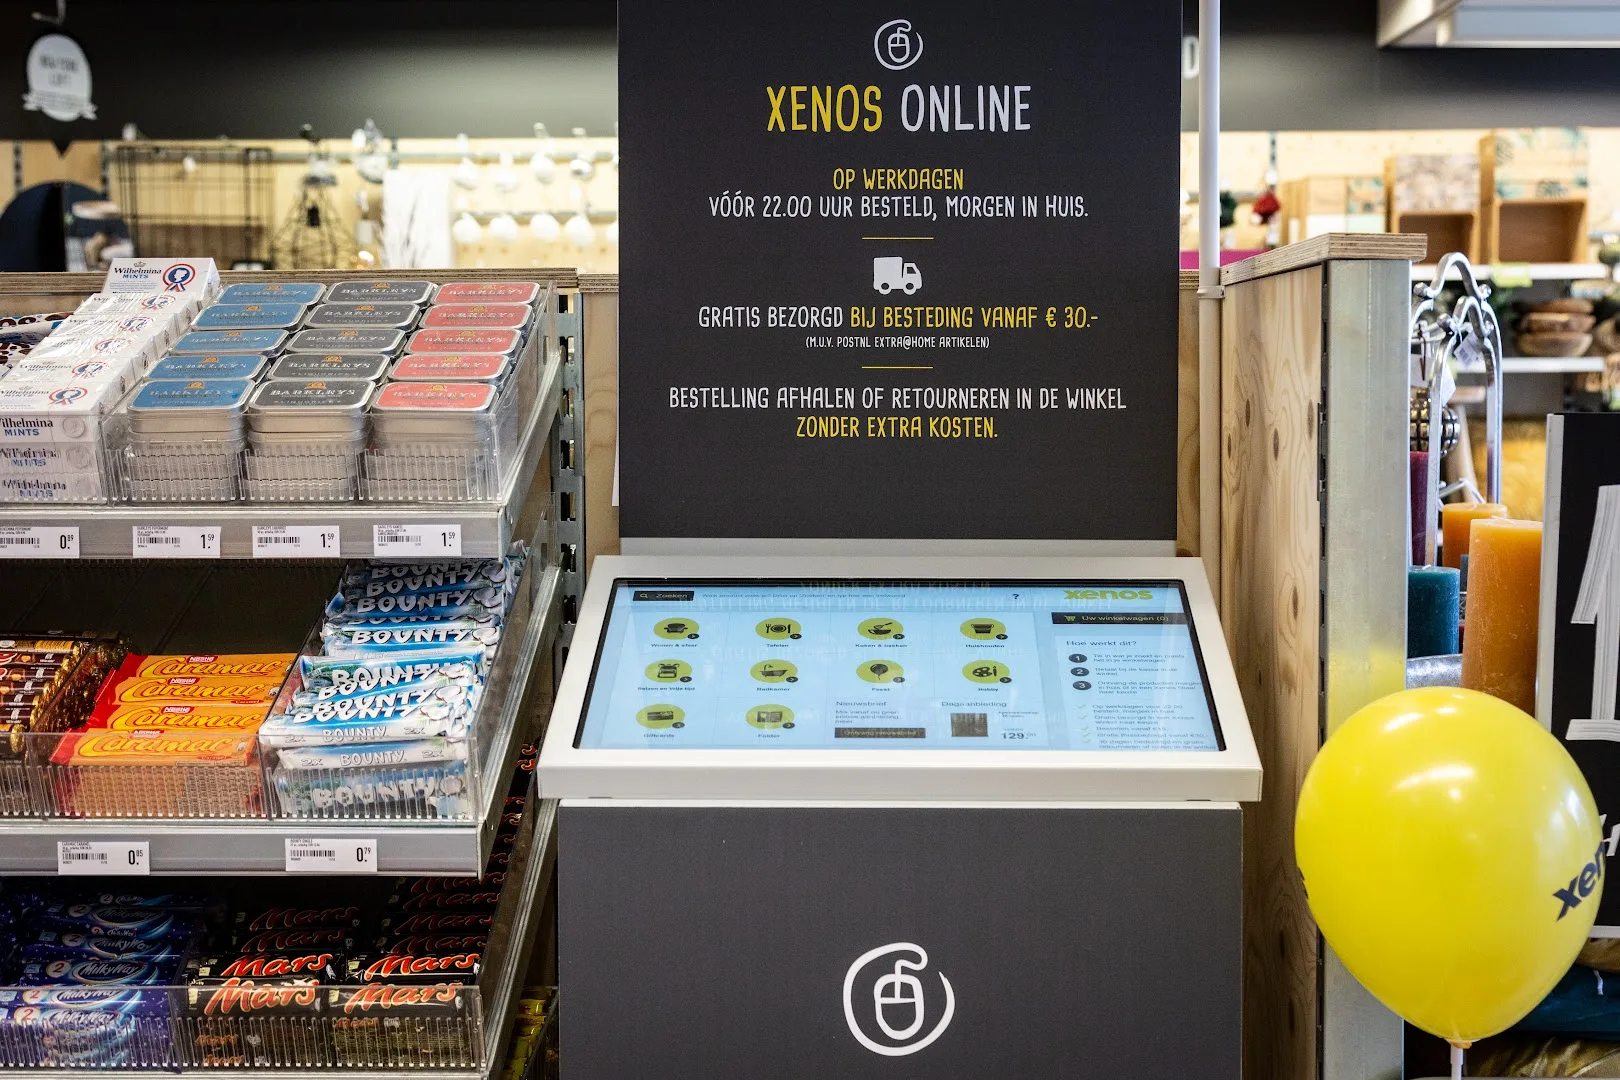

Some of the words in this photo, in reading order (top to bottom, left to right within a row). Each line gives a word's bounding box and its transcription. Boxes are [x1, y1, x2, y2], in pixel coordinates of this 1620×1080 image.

[767, 85, 882, 132] XENOS
[901, 84, 1031, 132] ONLINE
[834, 168, 855, 190] OP
[863, 168, 963, 190] WERKDAGEN
[709, 190, 754, 217] VÓÓR
[763, 196, 811, 217] 22.00
[820, 196, 852, 217] UUR
[861, 196, 940, 221] BESTELD,
[945, 196, 1014, 217] MORGEN
[1023, 196, 1037, 217] IN
[1046, 195, 1088, 217] HUIS.
[699, 306, 760, 327] GRATIS
[768, 306, 842, 327] BEZORGD
[851, 307, 875, 328] BIJ
[884, 307, 973, 328] BESTEDING
[981, 307, 1037, 328] VANAF
[1046, 307, 1056, 327] €
[1065, 307, 1098, 328] 30.-
[806, 337, 833, 348] (M.U.V.
[837, 336, 871, 347] POSTNL
[875, 336, 935, 349] EXTRA@HOME
[939, 337, 989, 348] ARTIKELEN)
[670, 387, 768, 408] BESTELLING
[777, 387, 854, 409] AFHALEN
[862, 387, 884, 408] OF
[892, 387, 1009, 409] RETOURNEREN
[1017, 388, 1031, 409] IN
[1040, 388, 1058, 409] DE
[1066, 388, 1126, 409] WINKEL
[0, 418, 53, 428] ilhelmina
[797, 416, 859, 437] ZONDER
[868, 417, 921, 437] EXTRA
[930, 416, 997, 438] KOSTEN.
[372, 560, 486, 579] BOUNTY
[367, 567, 479, 597] BOUNTY
[357, 589, 473, 613] BOUNTY
[1063, 589, 1153, 600] xenos
[352, 629, 473, 644] BOUNTY
[139, 657, 283, 677] Caramac
[119, 679, 266, 702] Caramac
[312, 688, 437, 713] BOUNTY
[112, 706, 261, 729] Caramac
[79, 734, 233, 757] Caramac
[322, 726, 387, 743] BOUNTY
[340, 750, 405, 767] BOUNTY
[313, 776, 436, 808] BOUNTY
[403, 892, 500, 911] Mars
[250, 906, 360, 930] Mars
[394, 913, 494, 935] Mars
[242, 929, 345, 952] Mars
[390, 935, 488, 953] Mars
[53, 963, 65, 973] 2
[80, 963, 139, 976] MilkyWay
[220, 953, 333, 976] Mars
[364, 953, 480, 980] Mars
[29, 990, 40, 999] 2
[203, 976, 320, 1015] Mars
[344, 982, 463, 1013] Mars
[22, 1008, 33, 1020] 2
